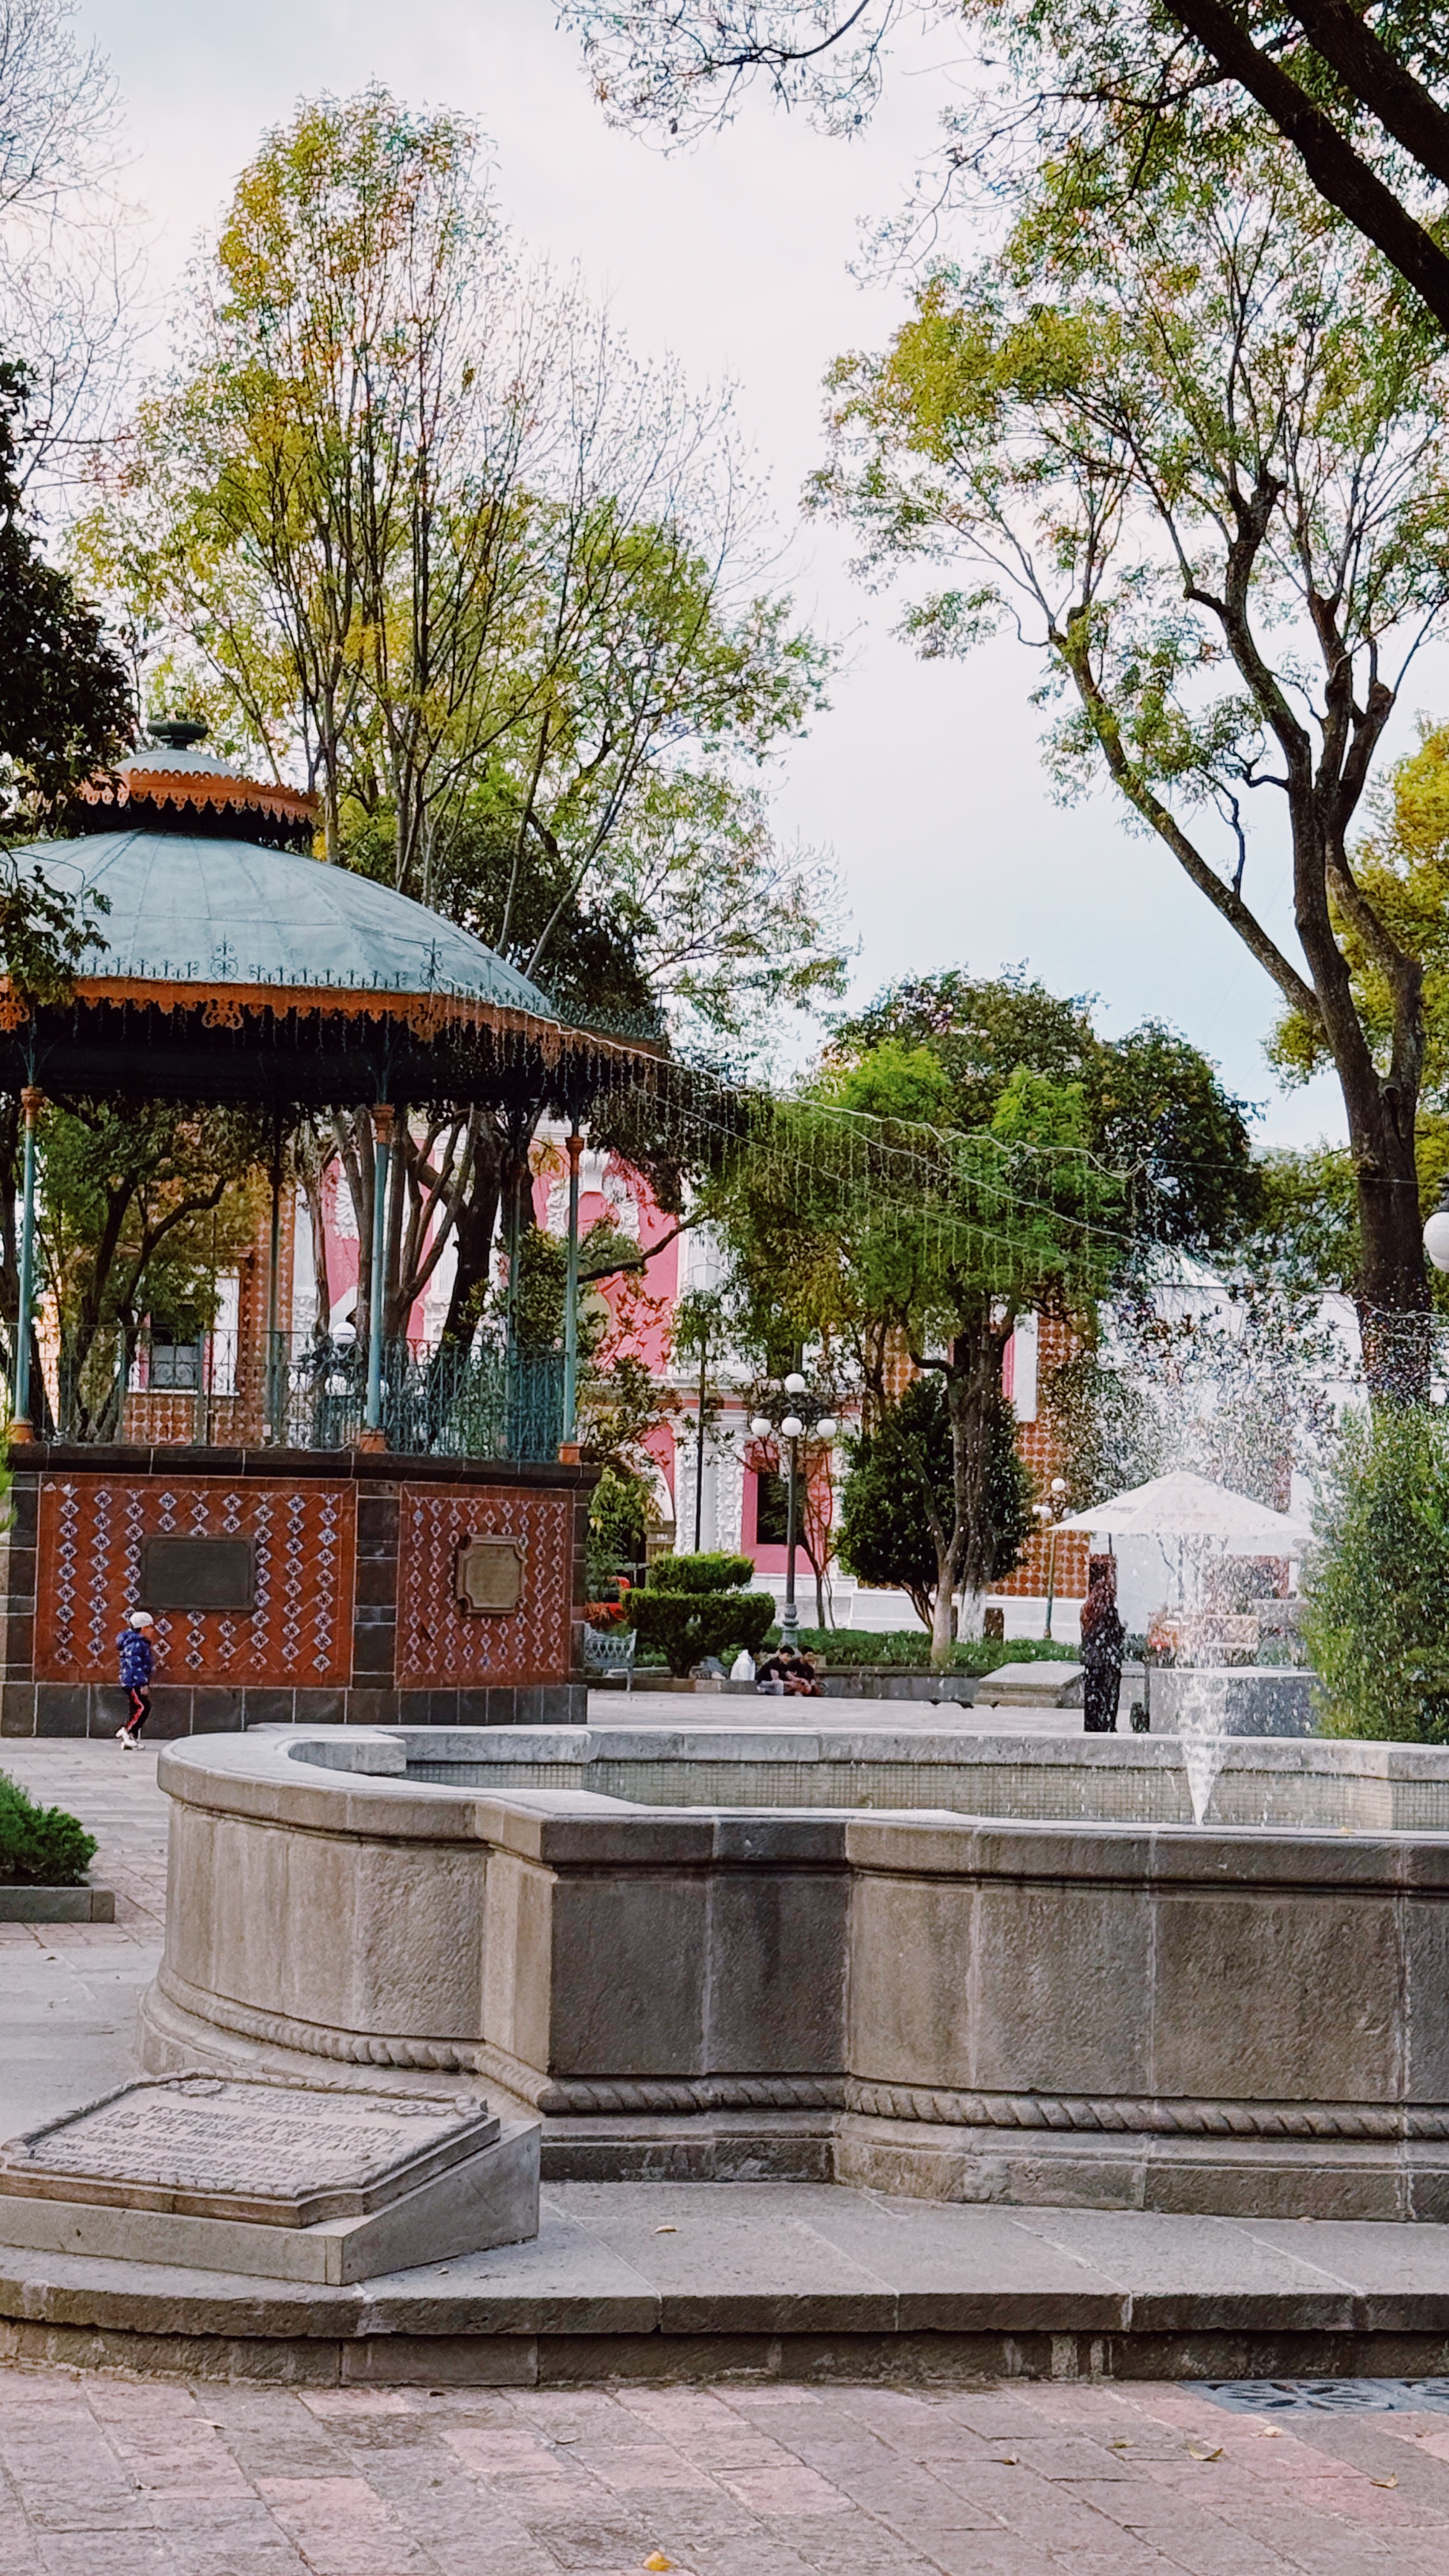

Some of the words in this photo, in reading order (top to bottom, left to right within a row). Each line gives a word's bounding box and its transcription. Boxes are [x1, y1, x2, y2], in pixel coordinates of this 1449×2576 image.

[104, 2110, 151, 2120] LOS
[141, 2115, 229, 2129] PUEBLOS
[221, 2124, 255, 2132] DE
[249, 2126, 284, 2135] LA
[277, 2129, 384, 2143] REPUBLICA
[378, 2138, 415, 2146] DE
[139, 2105, 243, 2121] TESTIMONIO
[236, 2116, 273, 2125] DE
[264, 2119, 350, 2131] AMISTAD
[343, 2126, 408, 2137] ENTRE
[182, 2128, 279, 2143] MUNICIPIO
[271, 2138, 307, 2147] DE
[300, 2140, 402, 2154] TLAXCALA
